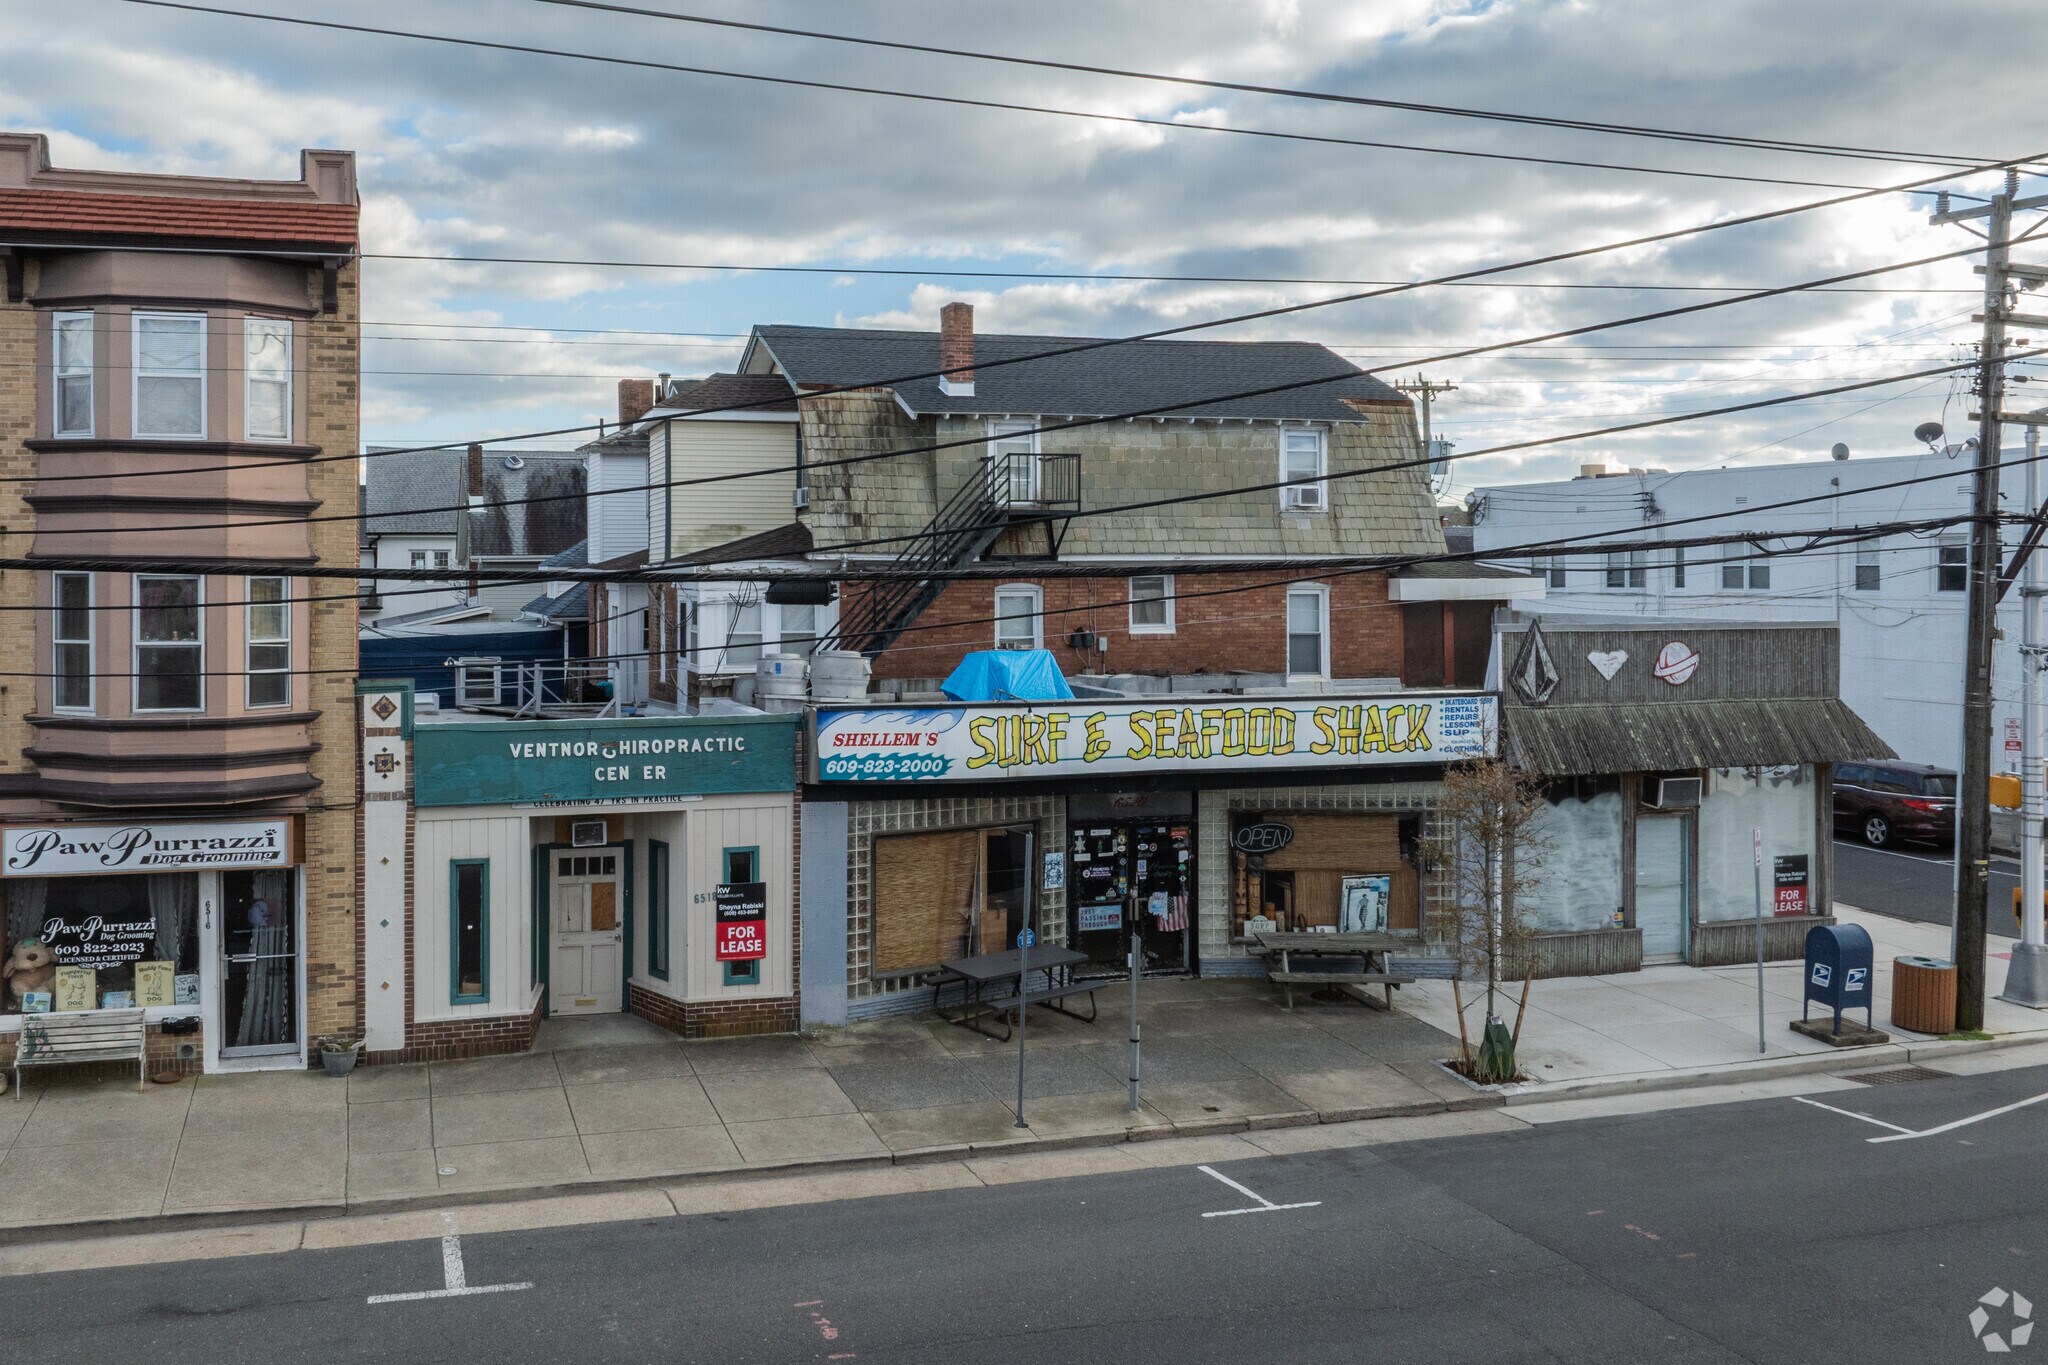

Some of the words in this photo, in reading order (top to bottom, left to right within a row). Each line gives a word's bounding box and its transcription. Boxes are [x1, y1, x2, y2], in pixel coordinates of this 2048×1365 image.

[1445, 713, 1478, 721] REPAIRS
[966, 713, 1070, 769] SURF
[1127, 708, 1296, 760] SEAFOOD
[1310, 704, 1433, 755] SHACK
[509, 741, 598, 758] VENTNOR
[826, 758, 943, 774] 609-823-2000
[534, 798, 590, 807] CELEBRATING
[595, 798, 605, 806] 47
[644, 795, 682, 803] PRACTICE
[1237, 828, 1287, 847] OPEN
[8, 830, 105, 869] Paw
[100, 827, 277, 866] Purrazzi
[149, 852, 184, 867] Dog
[188, 850, 273, 863] Grooming
[717, 885, 730, 894] kw
[1780, 890, 1799, 900] FOR
[694, 892, 716, 903] 6518
[1775, 901, 1803, 912] LEASE
[41, 917, 82, 943] Paw
[80, 916, 156, 941] Purrazzi
[100, 932, 115, 941] Dog
[117, 931, 155, 940] Grooming
[727, 926, 755, 939] FOR
[55, 944, 80, 956] 609
[83, 942, 145, 953] 822-2023
[721, 939, 762, 953] LEASE
